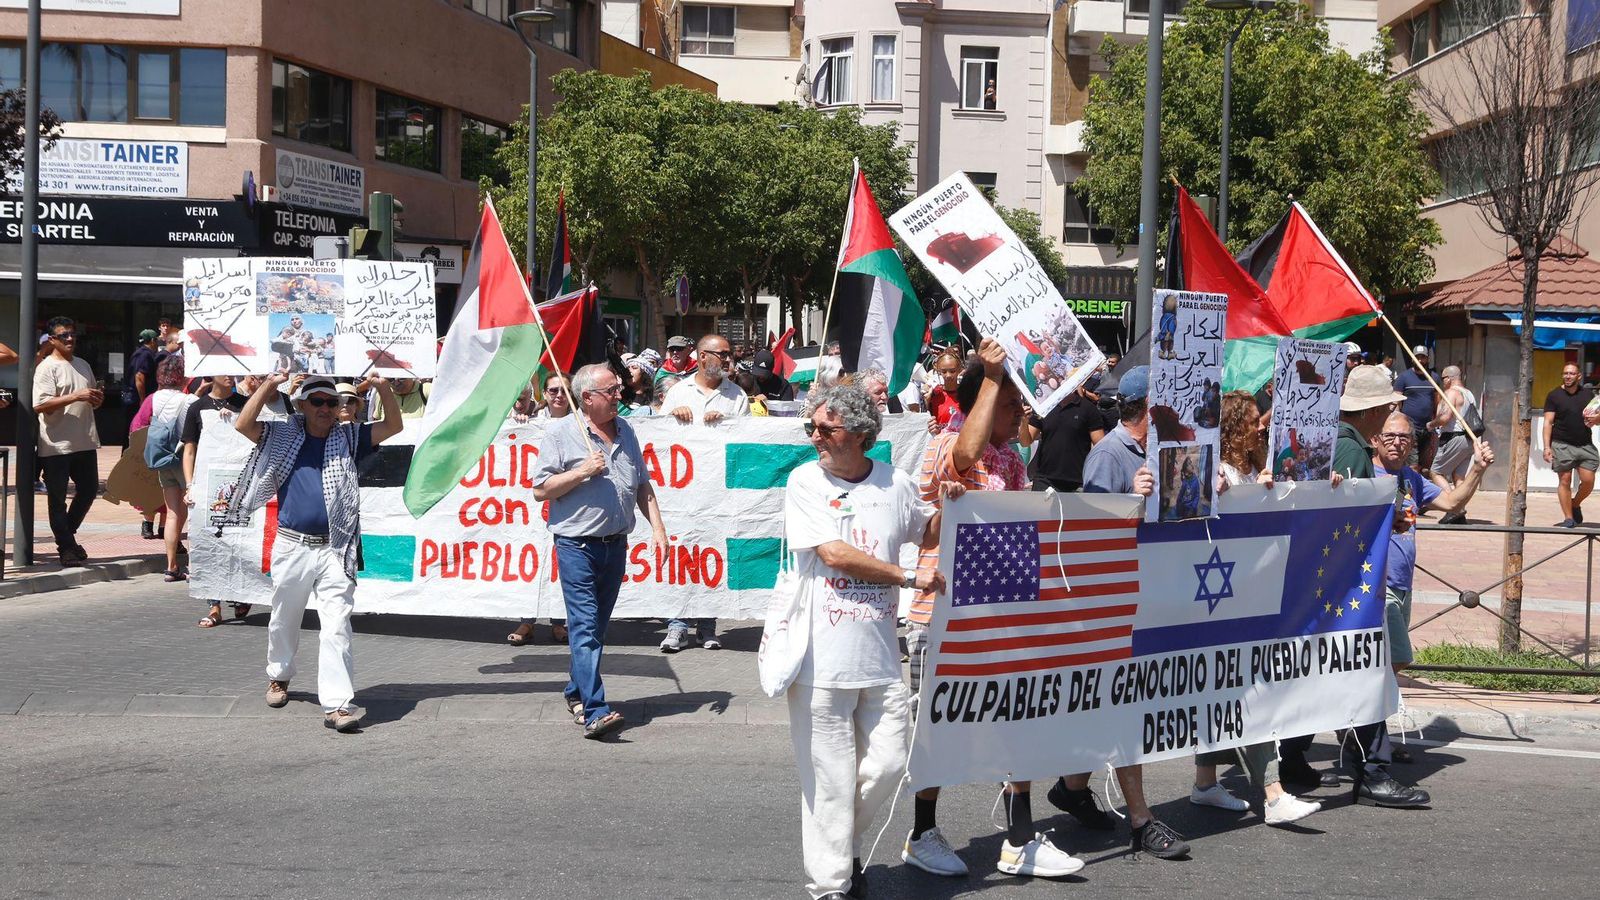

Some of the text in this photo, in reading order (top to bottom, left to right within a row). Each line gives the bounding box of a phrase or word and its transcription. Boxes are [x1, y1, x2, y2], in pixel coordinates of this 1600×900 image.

[296, 157, 361, 188] TRANSITAINER
[75, 184, 178, 193] www.transitainer.com
[902, 183, 962, 226] NINGÚN PUERTO
[185, 207, 218, 217] VENTA
[909, 191, 969, 235] PARA EL GENOCIDIO
[198, 220, 205, 229] Y
[275, 210, 336, 233] TELEFONIA
[274, 232, 293, 245] CAP
[1206, 295, 1227, 303] PUERTO
[1200, 303, 1227, 311] GENOCIDIO
[368, 321, 433, 334] GUERRA
[459, 497, 529, 527] con
[420, 539, 539, 582] PUEBLO
[824, 577, 848, 590] NO
[853, 608, 884, 622] PAZ
[930, 674, 1061, 724] CULPABLES
[1068, 668, 1102, 713] DEL
[1111, 653, 1207, 705] GENOCIDIO
[1215, 649, 1243, 690] DEL
[1252, 640, 1311, 684] PUEBLO
[1143, 699, 1243, 754] DESDE 1948
